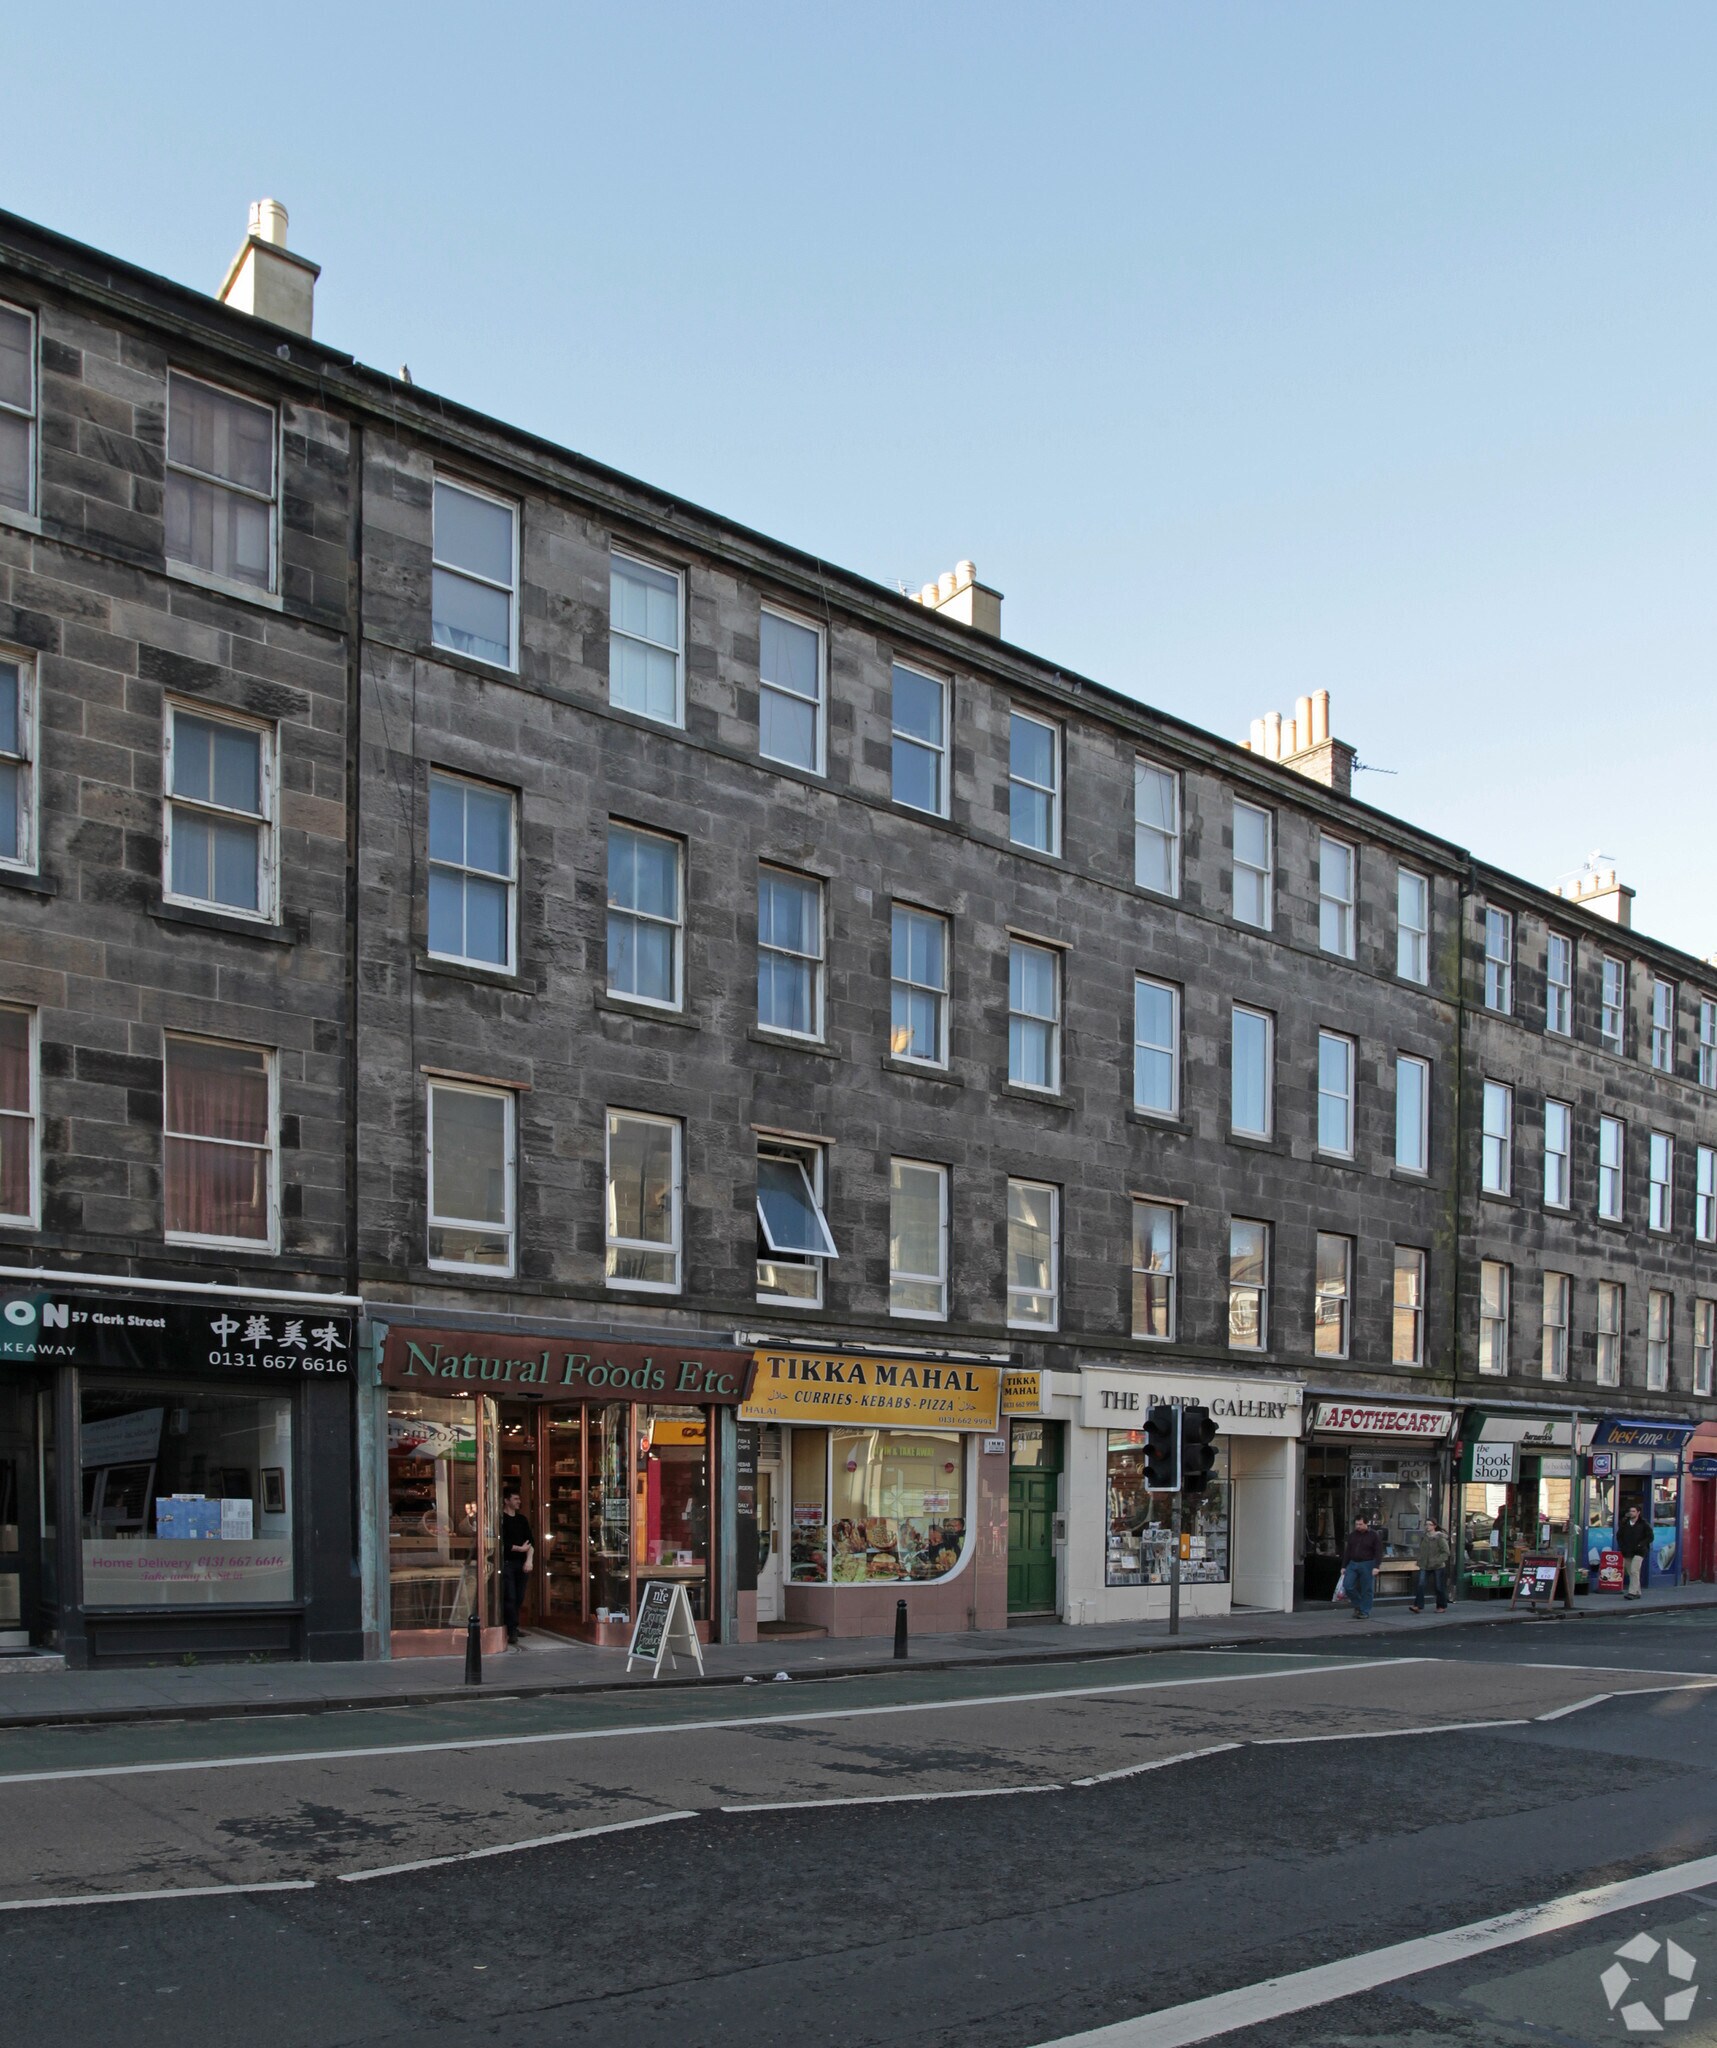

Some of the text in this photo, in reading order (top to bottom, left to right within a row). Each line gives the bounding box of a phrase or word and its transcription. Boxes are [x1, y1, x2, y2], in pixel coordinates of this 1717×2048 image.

[71, 1312, 166, 1328] 57 Clerk Street
[0, 1342, 76, 1355] KEAWAY
[209, 1351, 347, 1373] 0131 667 6616
[402, 1341, 549, 1384] Natural
[674, 1361, 740, 1394] Etc.
[767, 1356, 979, 1392] TIKKA MAHAL
[1007, 1376, 1036, 1386] TIKKA
[1005, 1387, 1039, 1396] MAHAL
[794, 1390, 954, 1411] CURRIES KEBABS PIZZA
[1101, 1391, 1139, 1410] THE
[1212, 1398, 1288, 1419] GALLERY
[746, 1406, 780, 1415] HALAL
[939, 1416, 955, 1424] 0131
[958, 1417, 972, 1425] 662
[1325, 1407, 1442, 1433] APOTHECARY
[1476, 1444, 1490, 1452] the
[1476, 1453, 1511, 1466] book
[1475, 1465, 1508, 1480] shop
[93, 1557, 133, 1568] Home
[138, 1557, 191, 1570] Delivery
[229, 1556, 252, 1567] 667
[255, 1555, 284, 1567] 6616
[653, 1588, 669, 1602] nfe
